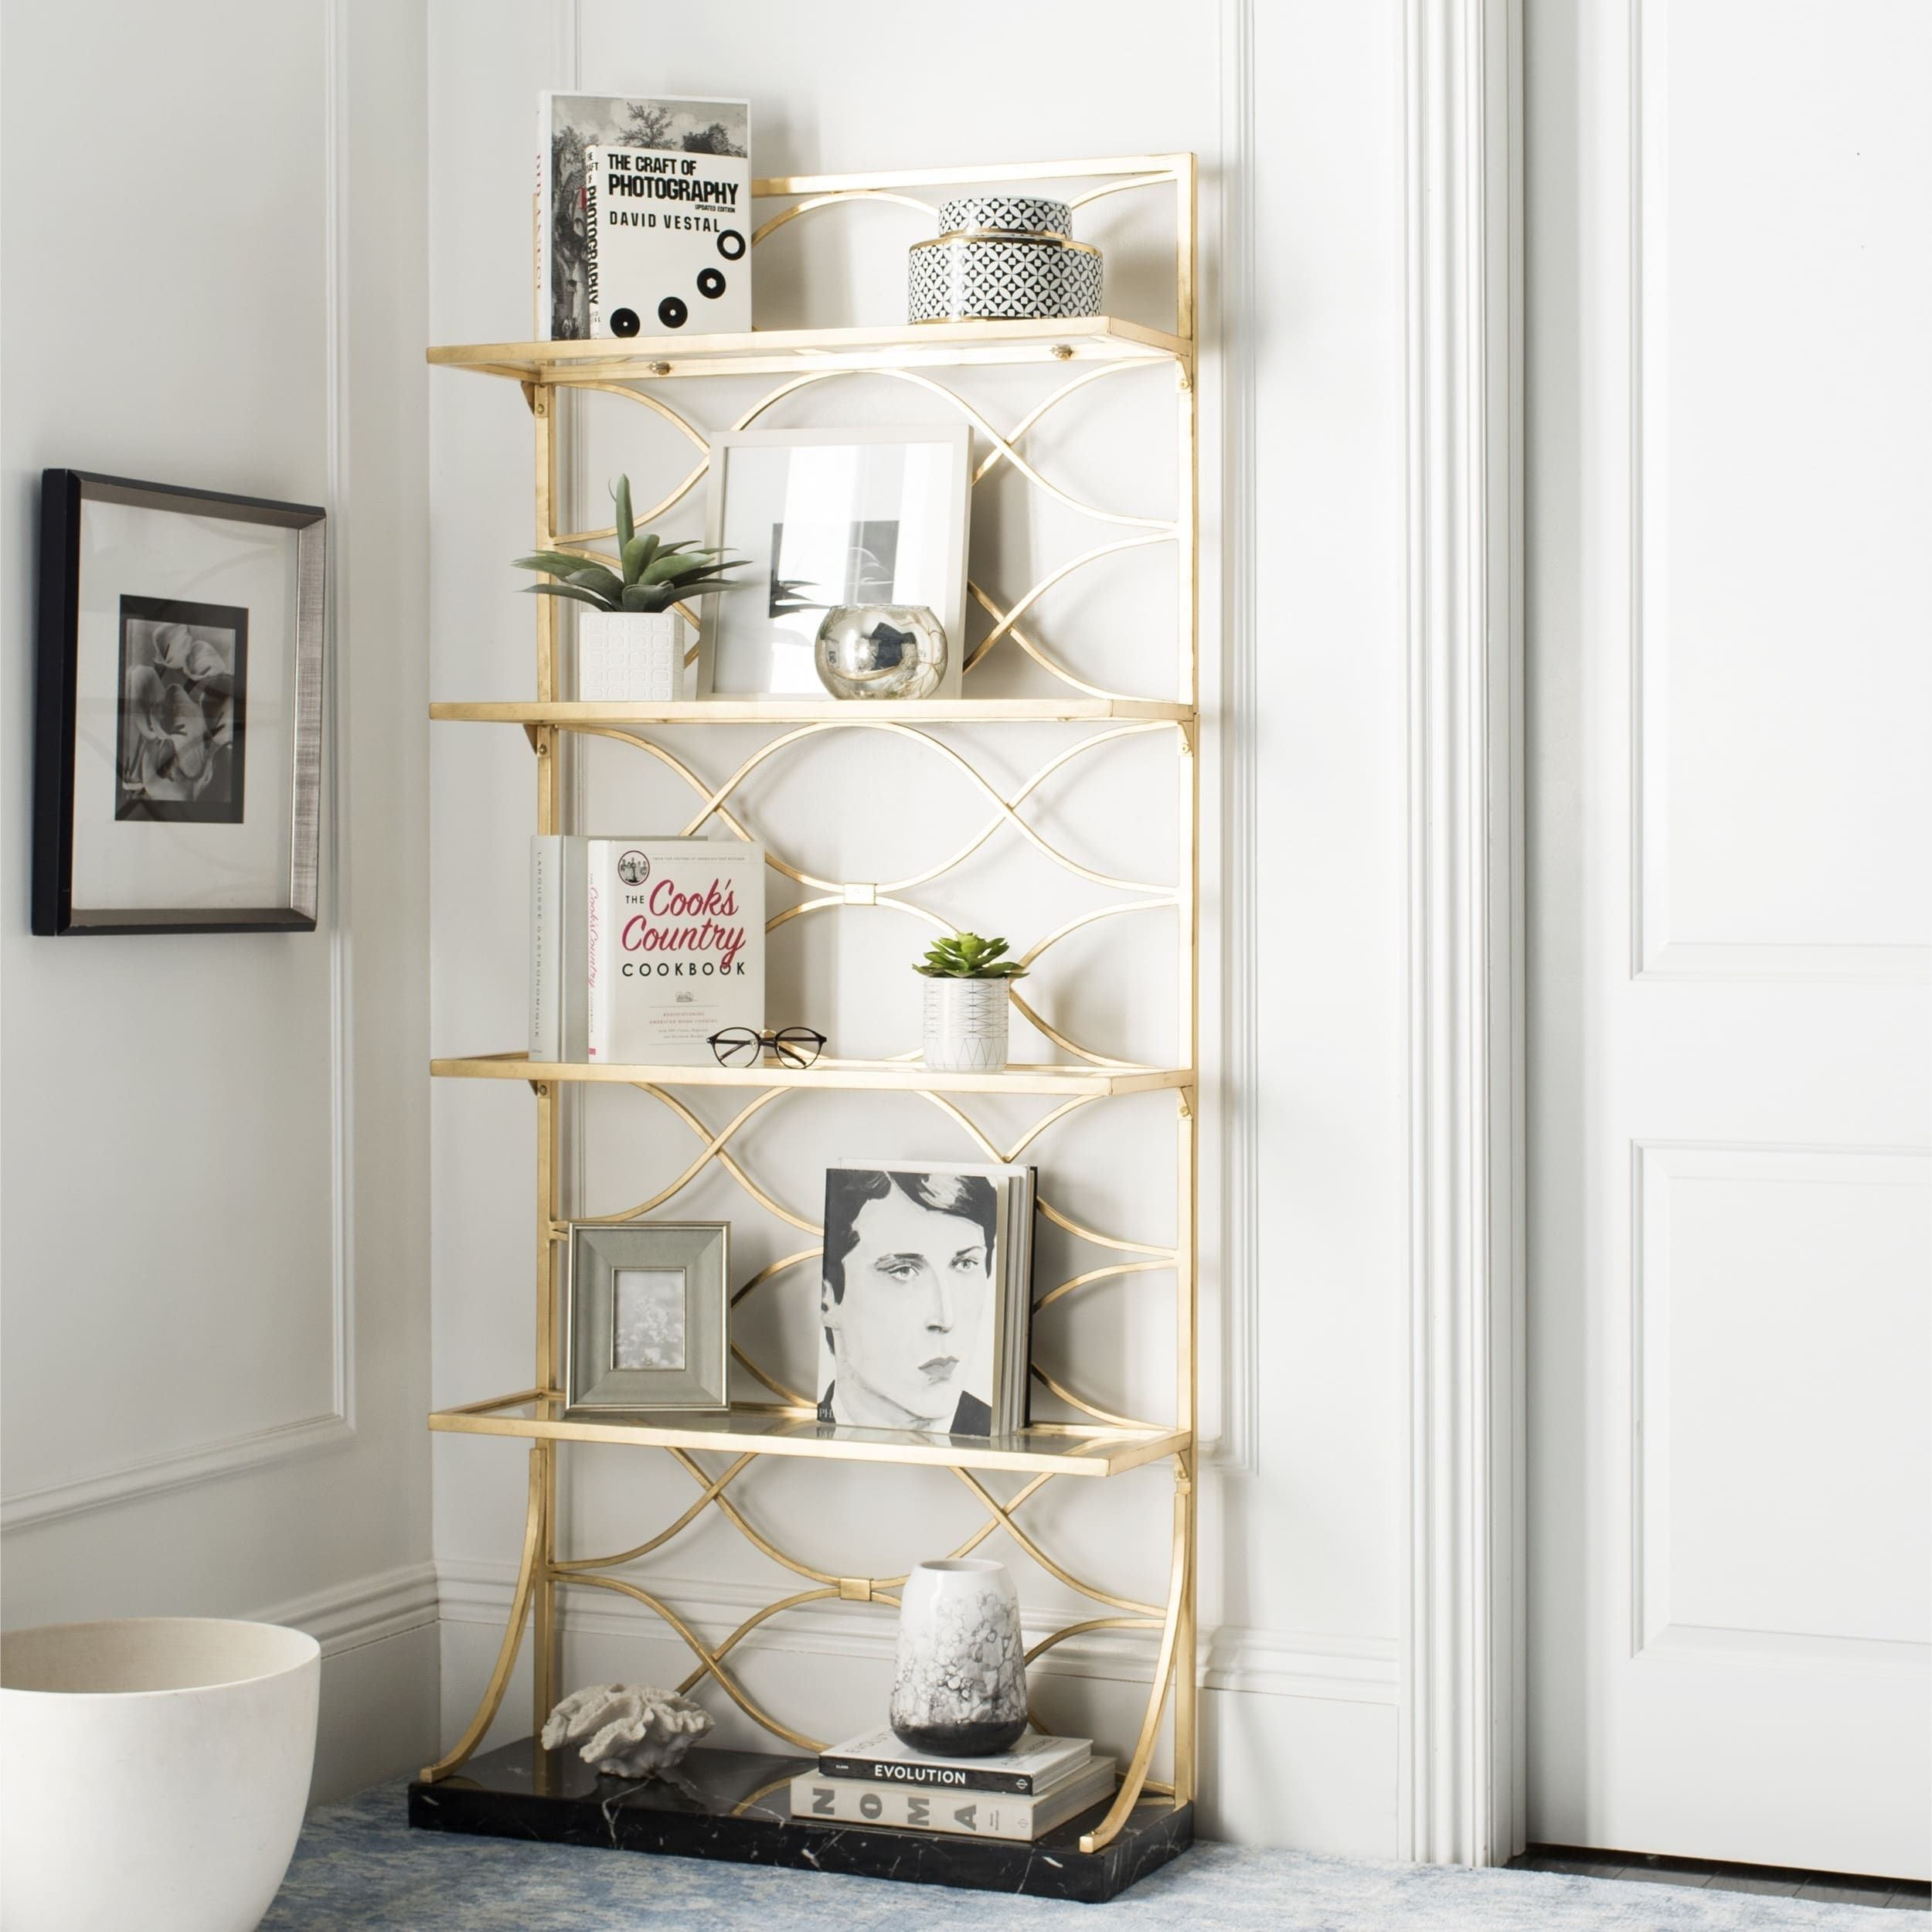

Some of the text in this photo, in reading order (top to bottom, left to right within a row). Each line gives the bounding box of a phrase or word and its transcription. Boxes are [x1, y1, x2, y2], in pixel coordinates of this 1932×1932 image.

[607, 153, 631, 171] THE
[635, 156, 677, 175] CRAFT
[681, 159, 697, 176] OF
[608, 174, 739, 205] PHOTOGRAPHY
[610, 211, 720, 233] DAVID VESTAL
[587, 185, 598, 305] PHOTOGRAPHY
[625, 878, 739, 917] THE Cook's
[621, 914, 746, 969] Country
[621, 961, 745, 977] COOKBOOK
[874, 1764, 966, 1785] EVOLUTION
[812, 1787, 977, 1832] NOMA
